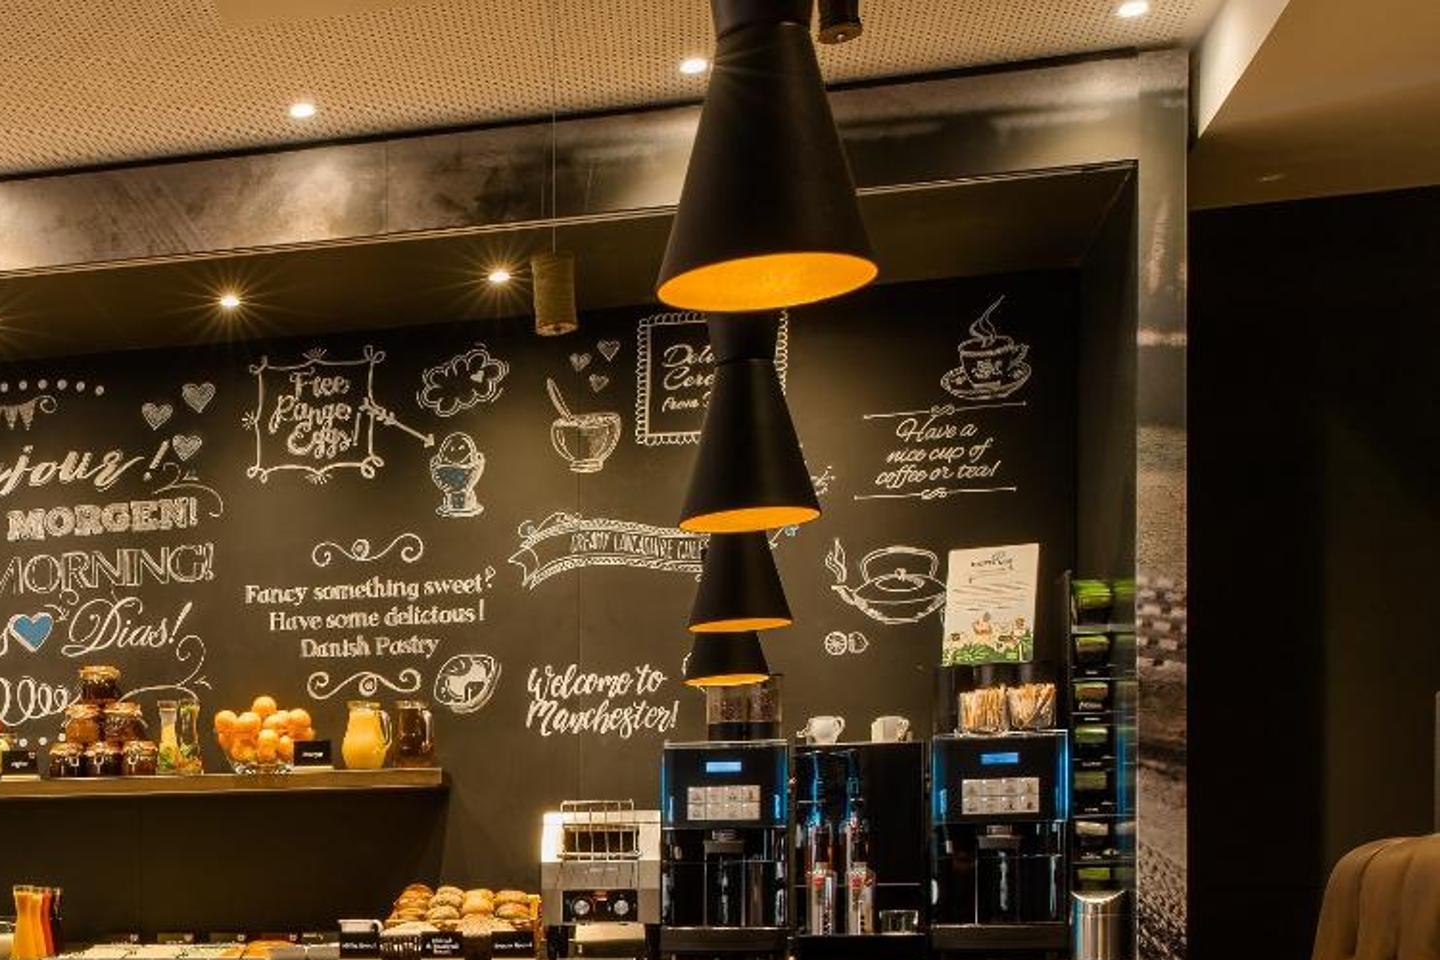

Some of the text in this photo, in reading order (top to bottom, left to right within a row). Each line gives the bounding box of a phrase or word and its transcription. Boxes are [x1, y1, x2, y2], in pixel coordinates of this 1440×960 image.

[290, 370, 351, 398] Free
[663, 366, 715, 390] Cere
[268, 394, 353, 435] Range
[896, 415, 978, 442] Have a
[886, 437, 994, 463] nice cup of
[875, 460, 1002, 489] coffee or tea!
[7, 496, 199, 542] MORGEN!
[244, 566, 496, 606] Fancy something sweet?
[269, 599, 484, 631] Have some delicious!
[300, 634, 440, 659] Danish Pastry
[527, 663, 668, 701] Welcome to
[525, 699, 680, 739] Manchester!
